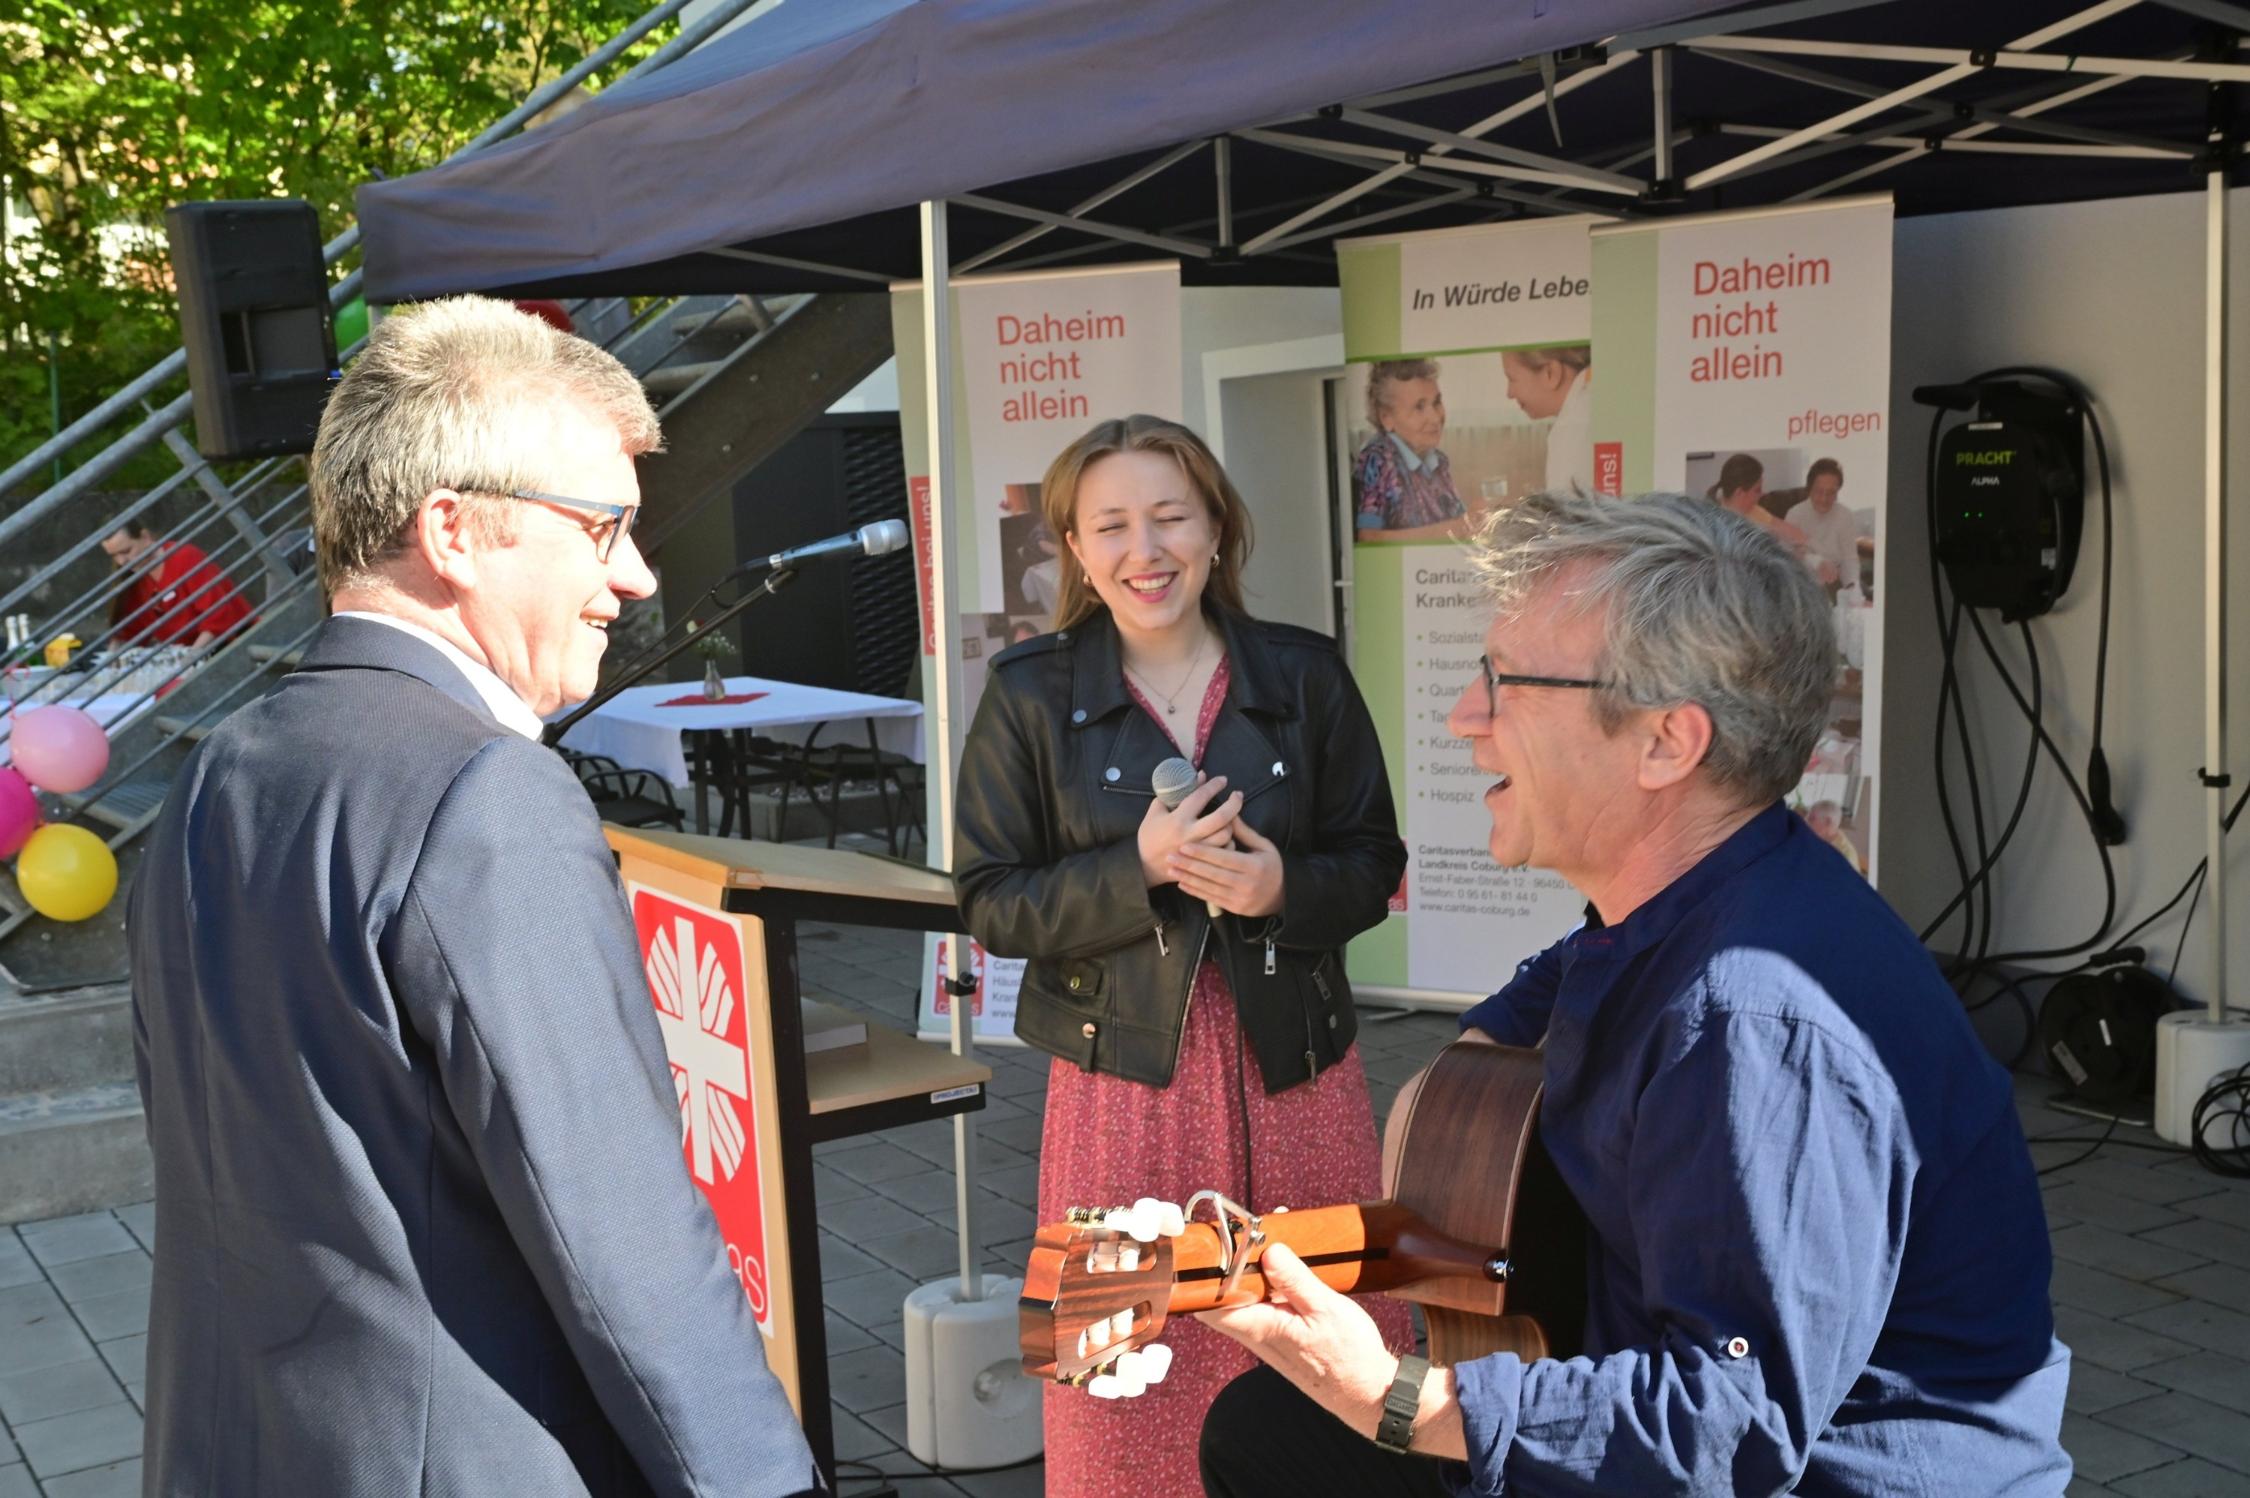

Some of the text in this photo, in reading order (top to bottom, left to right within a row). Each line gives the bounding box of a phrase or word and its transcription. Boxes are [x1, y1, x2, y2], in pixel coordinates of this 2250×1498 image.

[1694, 252, 1830, 296] Daheim
[1412, 275, 1593, 311] In Würde Lebe
[996, 309, 1126, 346] Daheim
[1692, 301, 1778, 339] nicht
[1000, 351, 1081, 384] nicht
[1690, 344, 1782, 383] allein
[1002, 388, 1088, 422] allein
[1788, 409, 1882, 441] pflegen
[1956, 450, 2013, 466] PRACHT
[1415, 568, 1475, 585] Carita
[1416, 592, 1478, 609] Kranke
[1430, 788, 1475, 804] Hospiz
